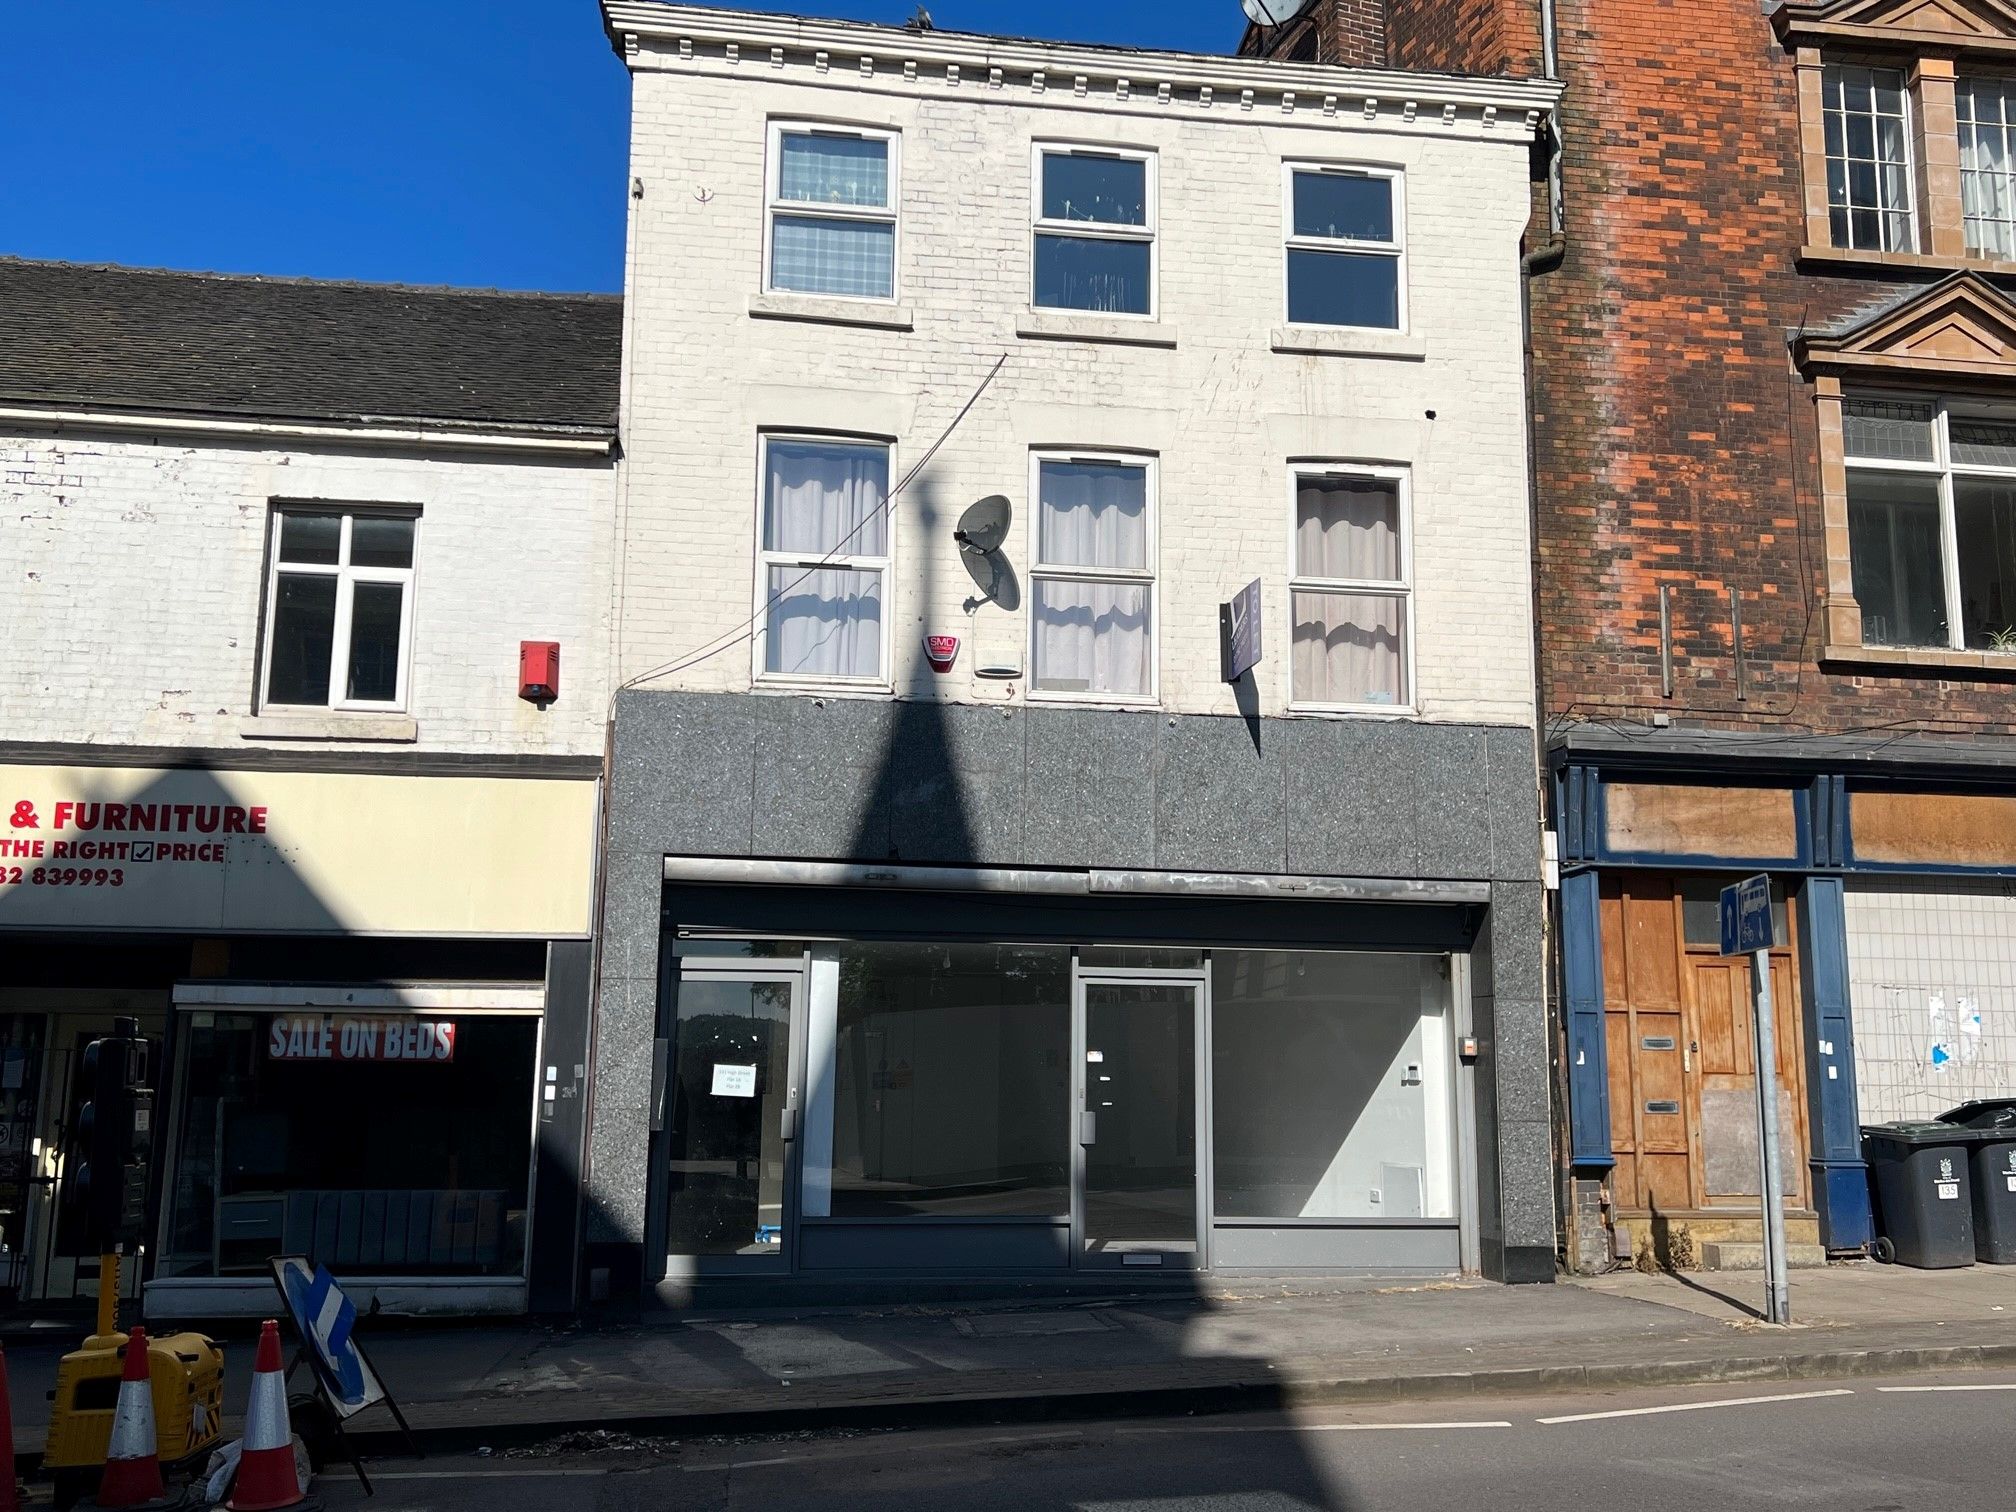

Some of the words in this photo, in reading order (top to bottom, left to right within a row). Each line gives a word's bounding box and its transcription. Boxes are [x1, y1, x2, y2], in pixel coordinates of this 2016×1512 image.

[930, 637, 953, 647] SMD
[10, 800, 40, 829] &
[53, 801, 268, 834] FURNITURE
[0, 839, 45, 858] THE
[53, 840, 130, 860] RIGHT
[156, 841, 224, 862] PRICE
[32, 866, 124, 887] 839993
[271, 1018, 333, 1058] SALE
[340, 1020, 377, 1059] ON
[384, 1022, 453, 1060] BEDS
[1941, 1185, 1956, 1196] 135
